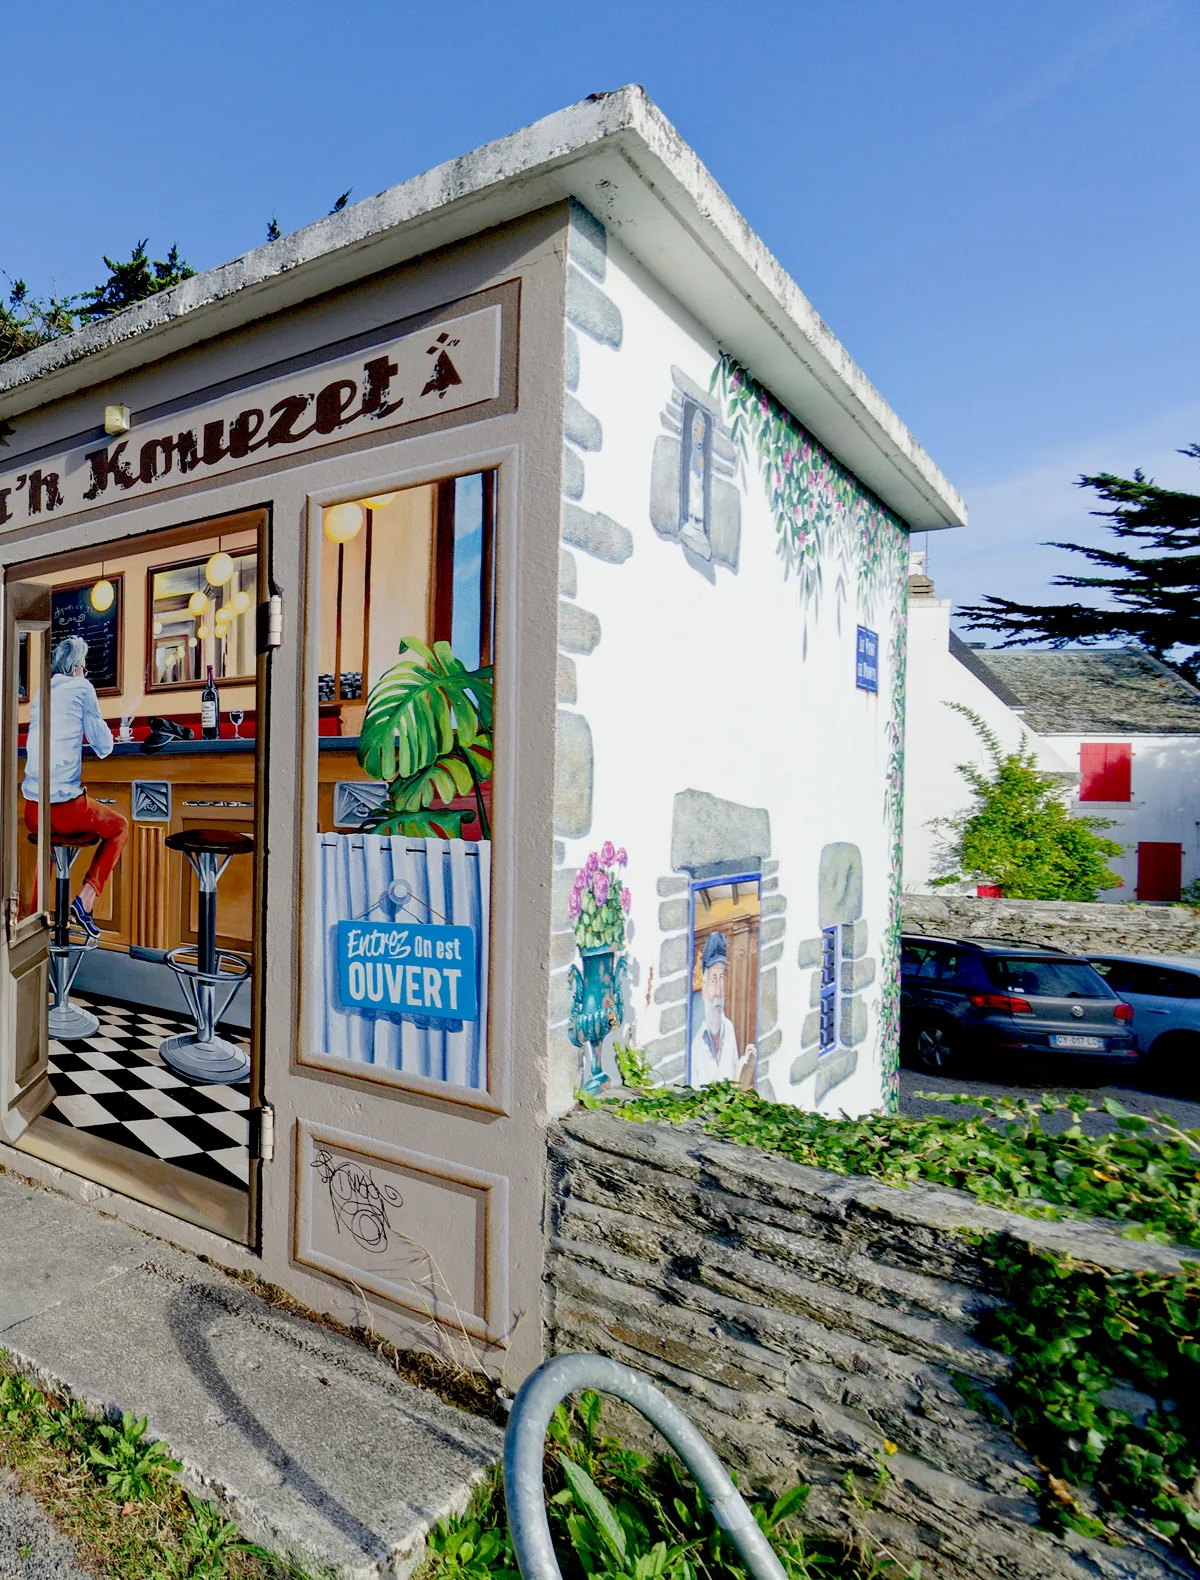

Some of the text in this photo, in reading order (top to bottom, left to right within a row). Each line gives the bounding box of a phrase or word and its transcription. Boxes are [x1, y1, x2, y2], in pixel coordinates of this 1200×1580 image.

[83, 355, 404, 501] Kouezet
[347, 928, 411, 960] Entrez
[435, 938, 462, 961] est
[348, 961, 463, 1010] OUVERT
